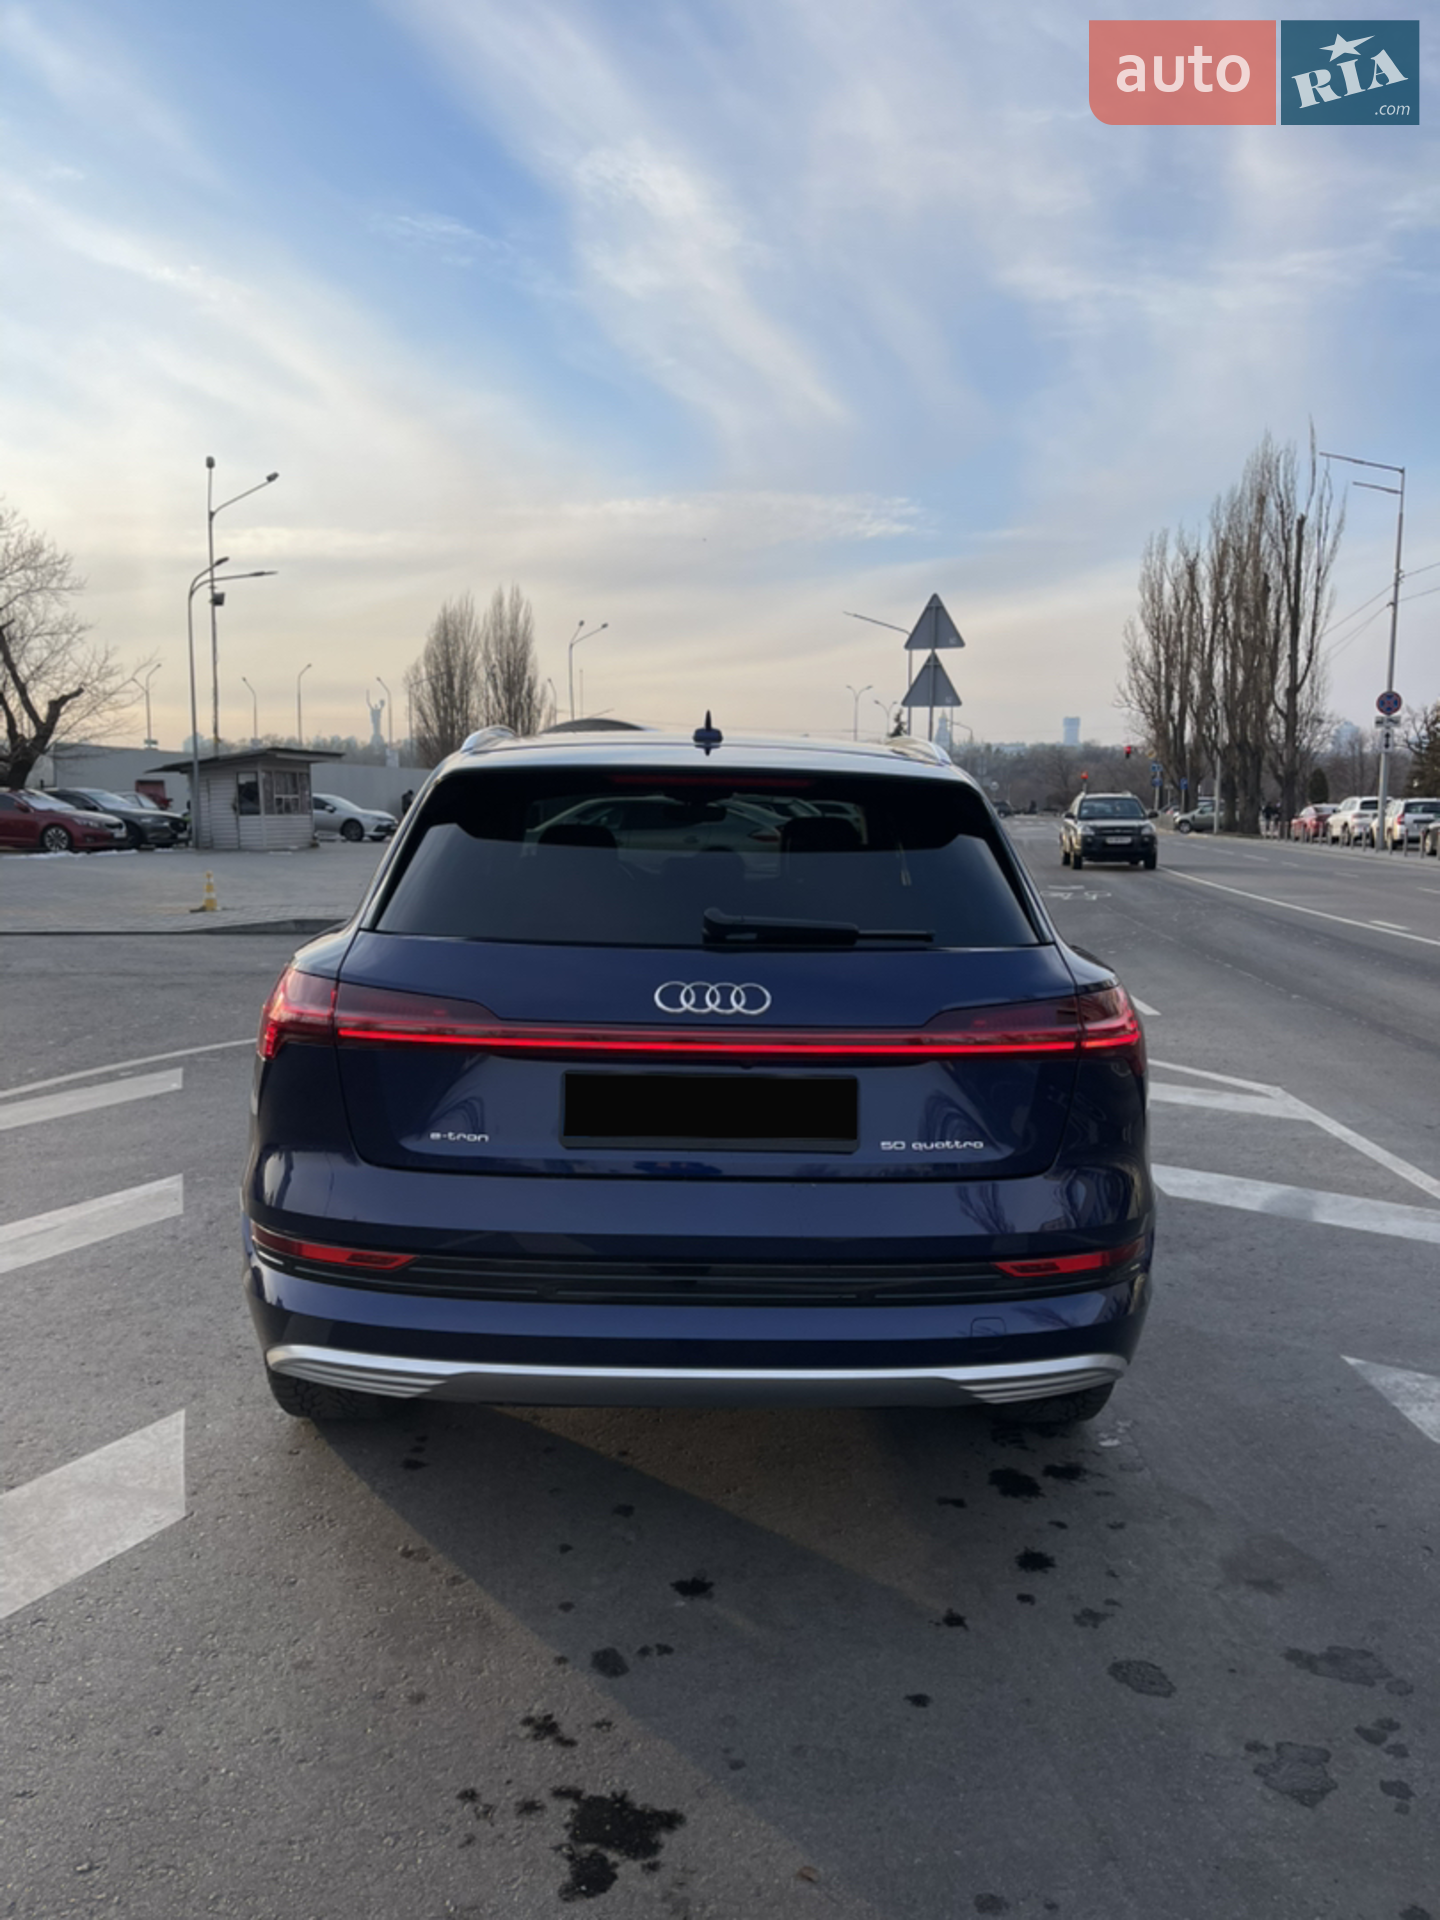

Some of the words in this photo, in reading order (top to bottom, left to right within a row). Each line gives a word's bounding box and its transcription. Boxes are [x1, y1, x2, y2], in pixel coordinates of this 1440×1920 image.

[429, 1131, 489, 1142] e-tron
[880, 1141, 906, 1150] 50
[911, 1140, 984, 1151] quattro
